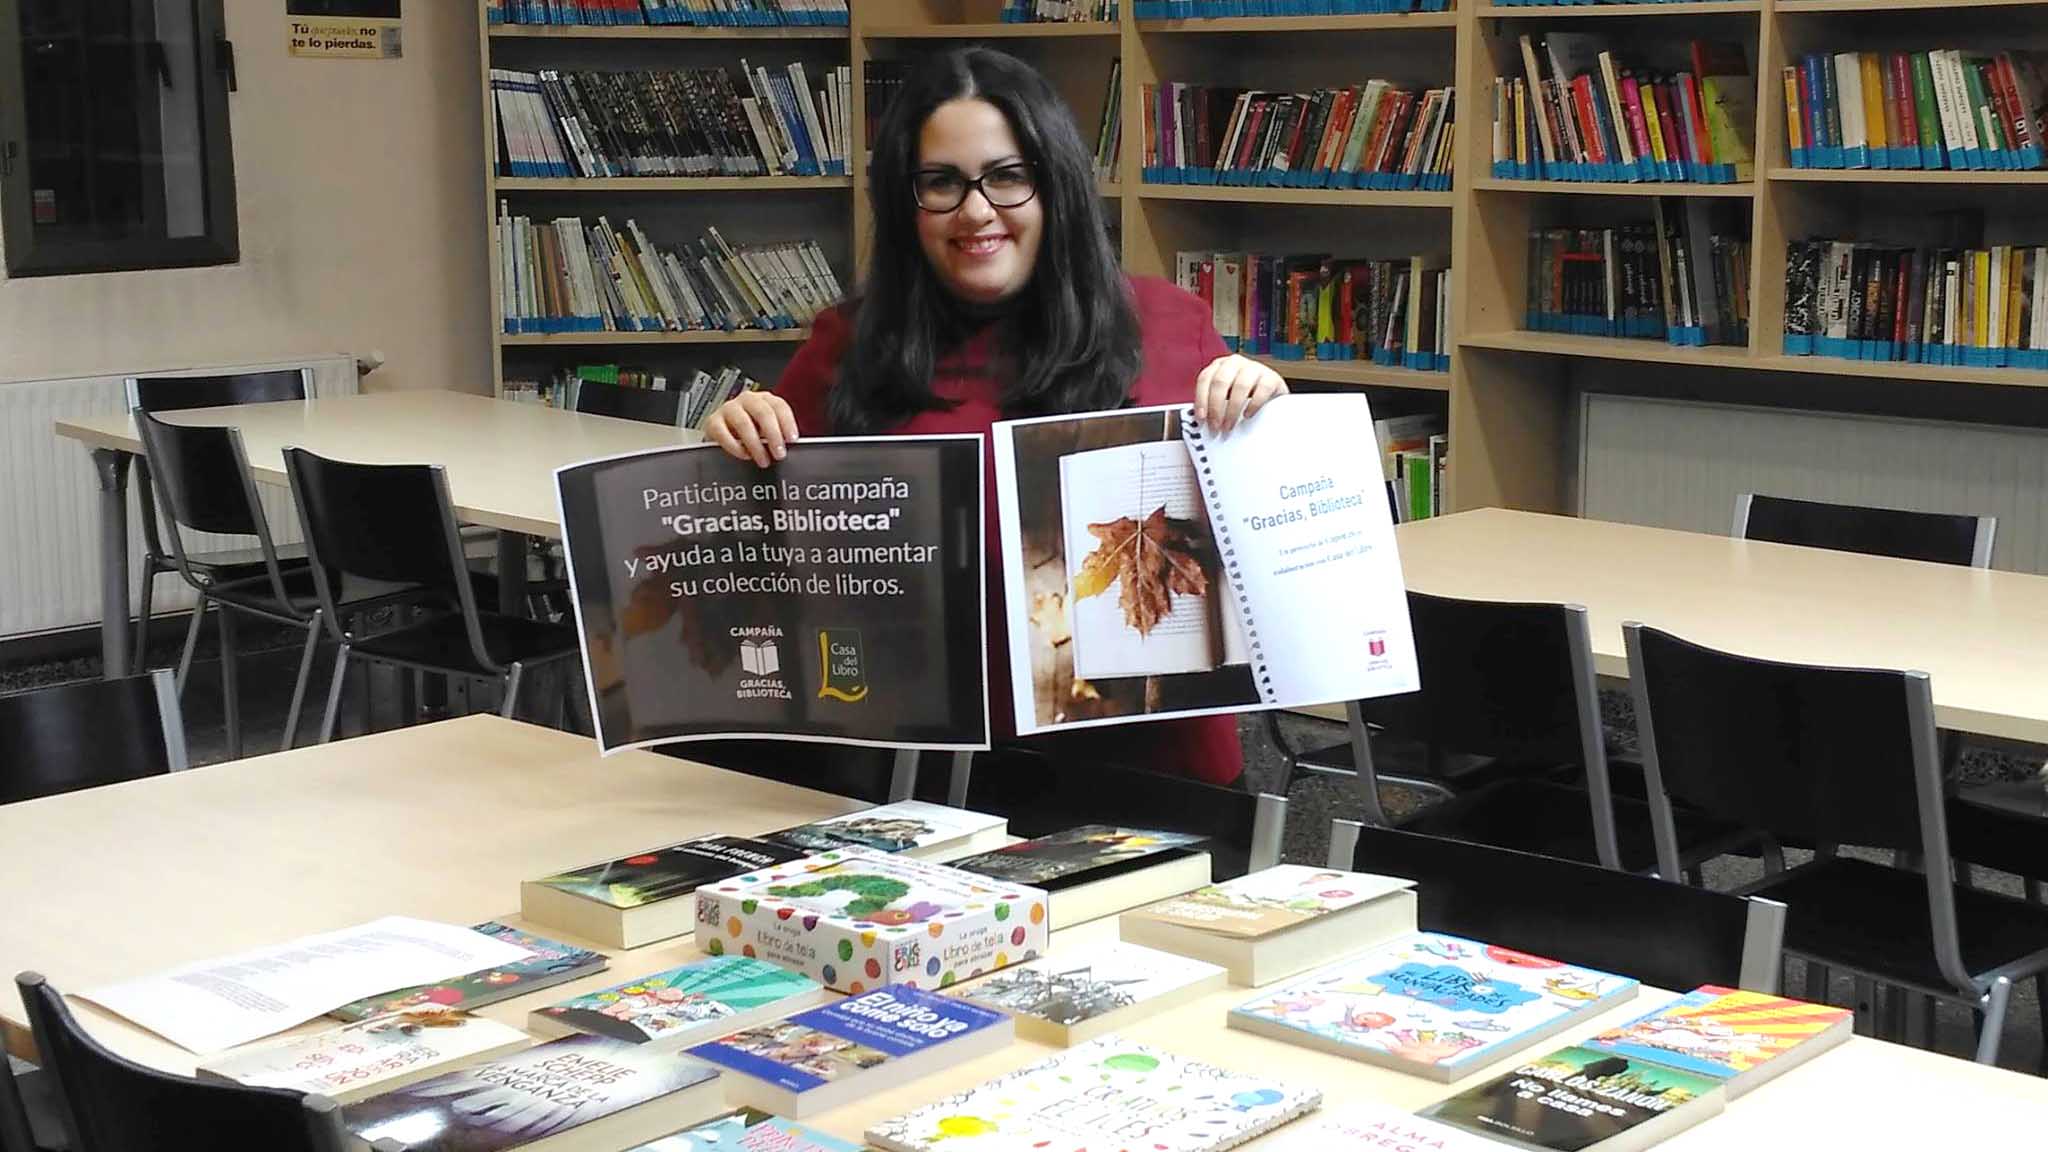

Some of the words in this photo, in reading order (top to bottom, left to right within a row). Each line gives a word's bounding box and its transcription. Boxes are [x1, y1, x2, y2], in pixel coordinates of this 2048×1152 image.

[292, 38, 306, 48] te
[309, 37, 322, 48] lo
[325, 38, 376, 50] pierdas.
[359, 27, 377, 36] no
[642, 481, 747, 510] Participa
[752, 484, 777, 500] en
[781, 479, 800, 500] la
[805, 477, 909, 504] campaña
[1279, 475, 1335, 500] Campaña
[661, 509, 770, 534] "Gracias,
[772, 508, 900, 532] Biblioteca"
[1242, 508, 1308, 531] "Gracias,
[624, 558, 640, 578] y
[645, 544, 715, 573] ayuda
[720, 546, 733, 563] a
[738, 541, 757, 562] la
[762, 542, 805, 567] tuya
[810, 548, 822, 563] a
[827, 542, 938, 563] aumentar
[670, 580, 698, 597] su
[702, 572, 801, 594] colección
[806, 573, 831, 594] de
[836, 573, 905, 595] libros.
[730, 625, 783, 637] CAMPAÑA
[830, 643, 856, 656] Casa
[843, 657, 858, 666] del
[832, 663, 858, 677] Libro
[736, 689, 792, 700] BIBLIOTECA
[943, 943, 970, 960] Libro
[840, 1001, 900, 1024] come
[897, 1018, 950, 1039] solo
[856, 992, 897, 1009] El
[881, 999, 938, 1023] niño
[936, 1017, 969, 1033] ya
[534, 1060, 616, 1085] SCHEPP
[557, 1053, 637, 1079] EMELIE
[474, 1068, 588, 1109] VENGANZA
[1510, 1079, 1546, 1094] No
[1547, 1089, 1627, 1118] llames
[1516, 1091, 1535, 1100] a
[1536, 1096, 1595, 1118] casa
